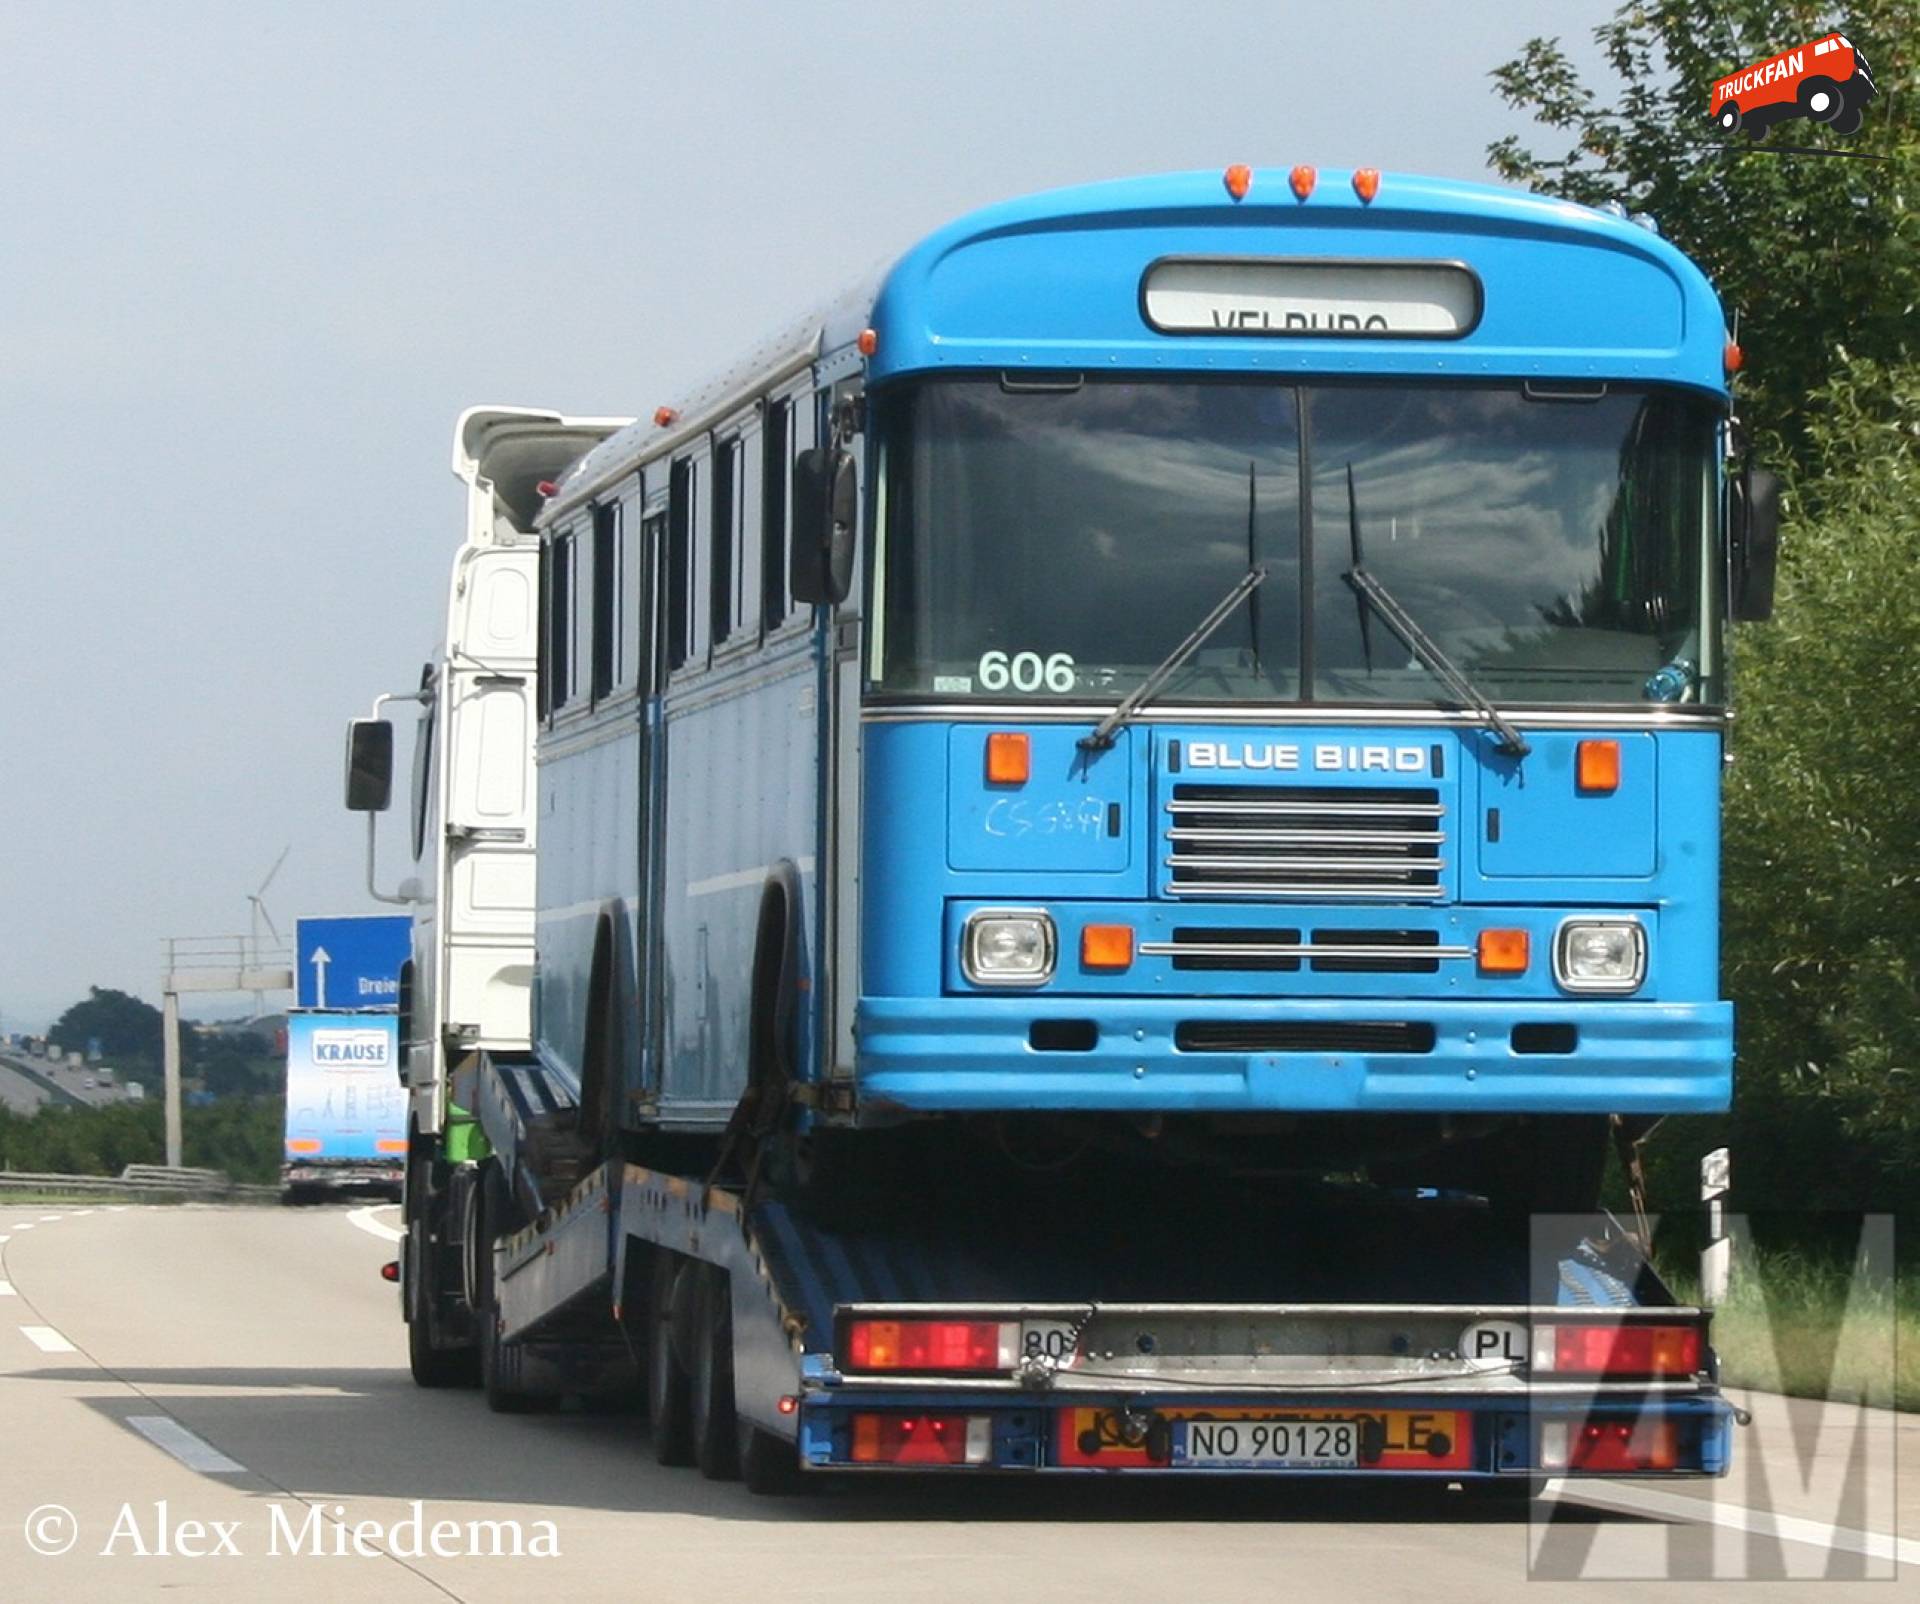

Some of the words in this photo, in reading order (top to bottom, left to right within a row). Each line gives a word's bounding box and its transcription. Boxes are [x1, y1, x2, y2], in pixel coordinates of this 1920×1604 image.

[979, 650, 1076, 692] 606
[1188, 743, 1299, 769] BLUE
[1315, 745, 1425, 771] BIRD
[316, 1043, 385, 1061] KRAUSE
[1475, 1330, 1525, 1361] PL
[1192, 1425, 1239, 1457] NO
[1252, 1426, 1351, 1458] 90128
